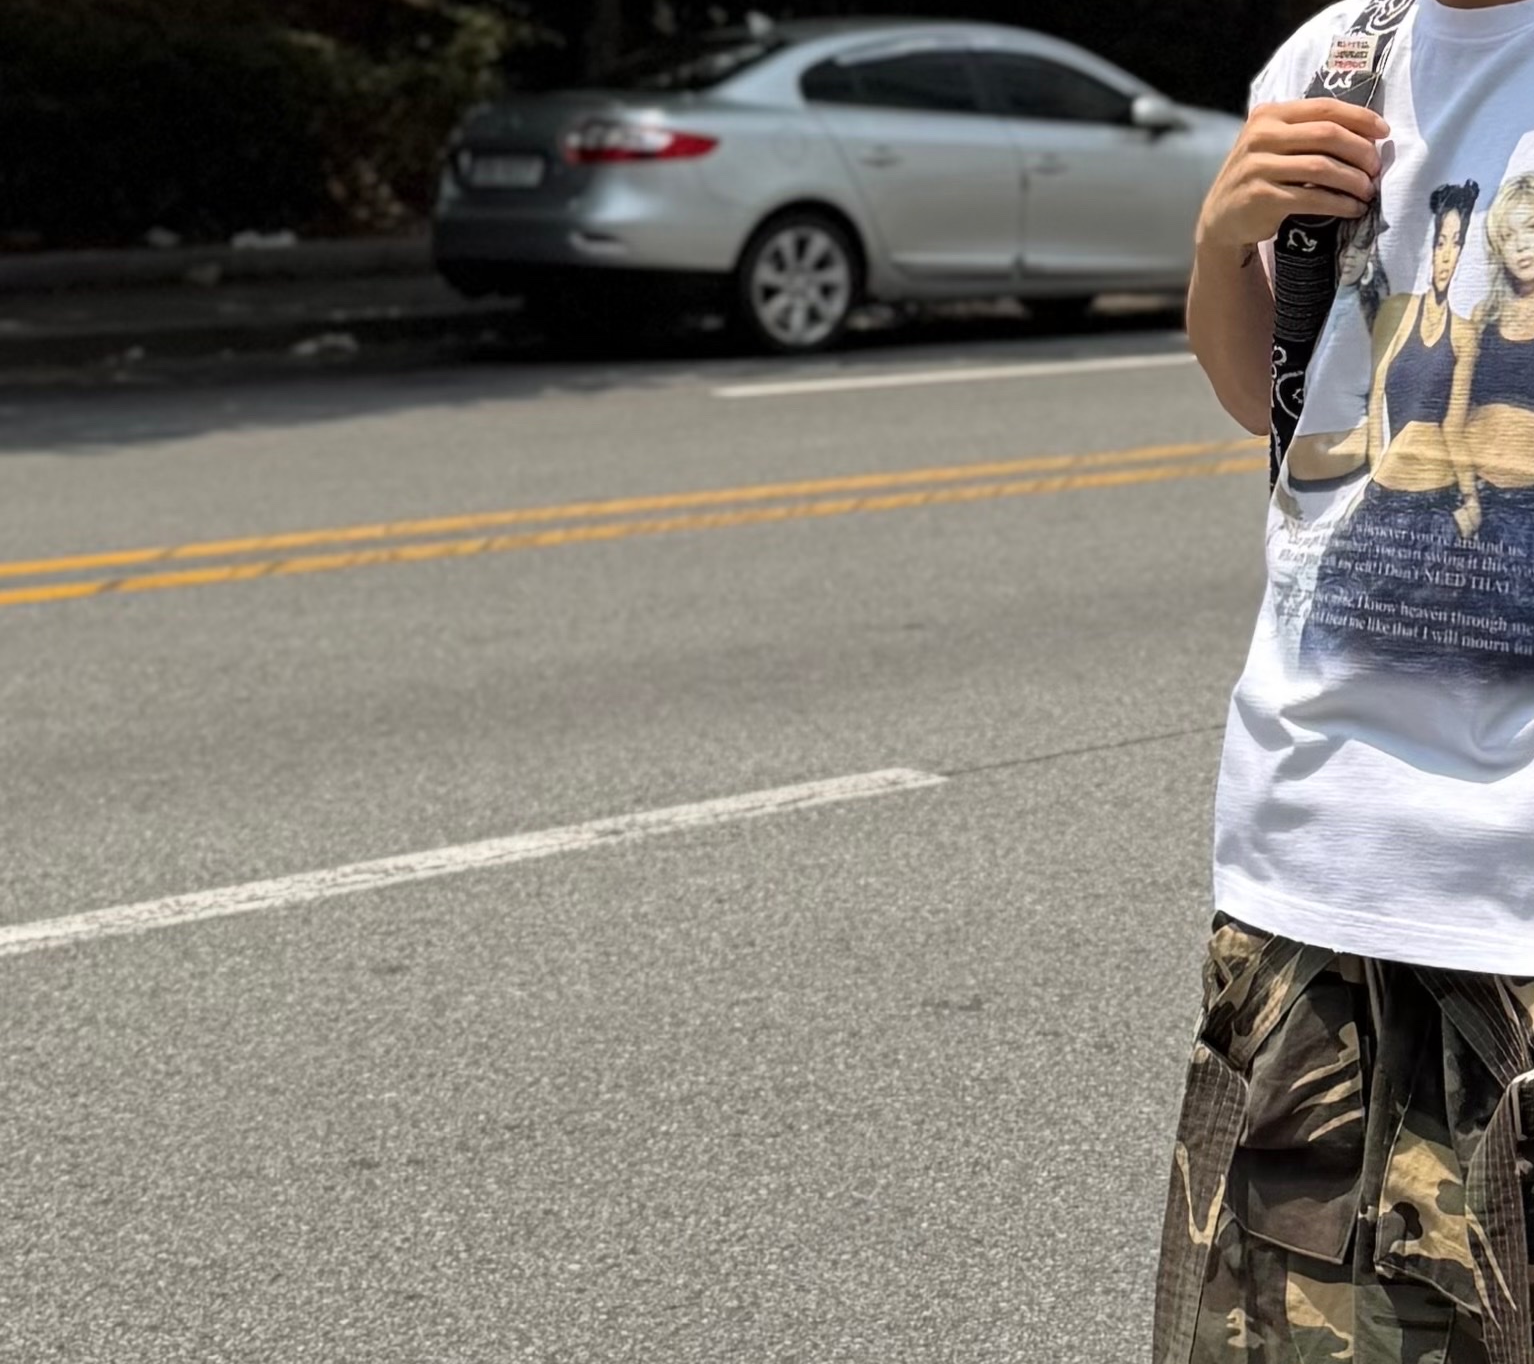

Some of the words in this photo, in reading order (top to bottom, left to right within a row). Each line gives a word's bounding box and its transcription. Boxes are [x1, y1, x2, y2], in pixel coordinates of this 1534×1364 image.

[1424, 551, 1465, 571] swing
[1467, 554, 1478, 570] it
[1481, 556, 1508, 573] this
[1424, 568, 1466, 588] NEED
[1364, 595, 1397, 613] know
[1400, 600, 1448, 622] heaven
[1451, 609, 1508, 634] through
[1367, 616, 1390, 635] like
[1393, 621, 1419, 638] that
[1432, 629, 1459, 646] will
[1462, 635, 1510, 653] mourn
